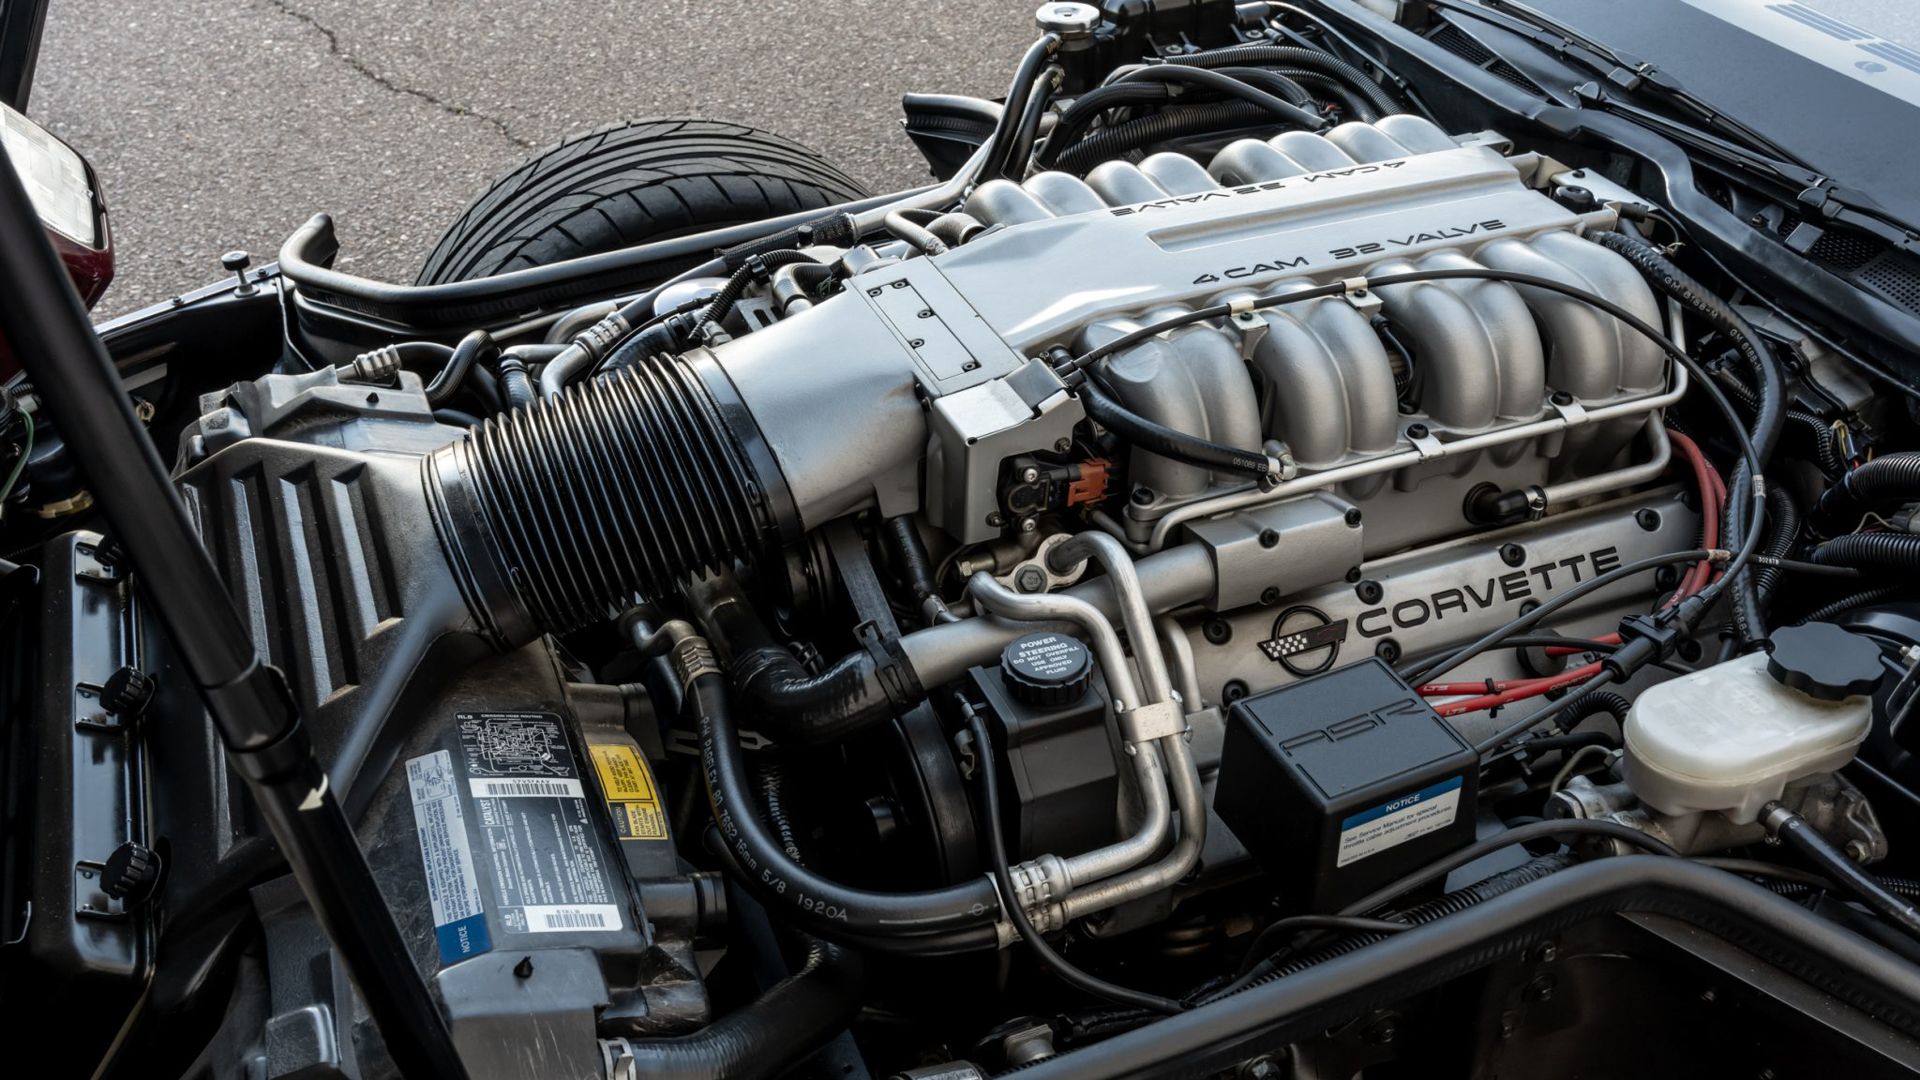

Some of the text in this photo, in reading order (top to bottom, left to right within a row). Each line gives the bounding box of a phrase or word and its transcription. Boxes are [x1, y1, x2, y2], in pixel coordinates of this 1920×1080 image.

[1664, 276, 1681, 291] GM
[1355, 546, 1622, 638] CORVETTE
[1019, 643, 1067, 657] STEERING
[1020, 636, 1057, 649] POWER
[479, 799, 495, 824] CATALYST
[1385, 793, 1421, 813] NOTICE
[615, 807, 627, 833] CAUTION
[736, 838, 758, 870] 16mm
[761, 869, 787, 895] 5/8
[797, 893, 848, 922] 1920A
[458, 924, 470, 953] NOTICE
